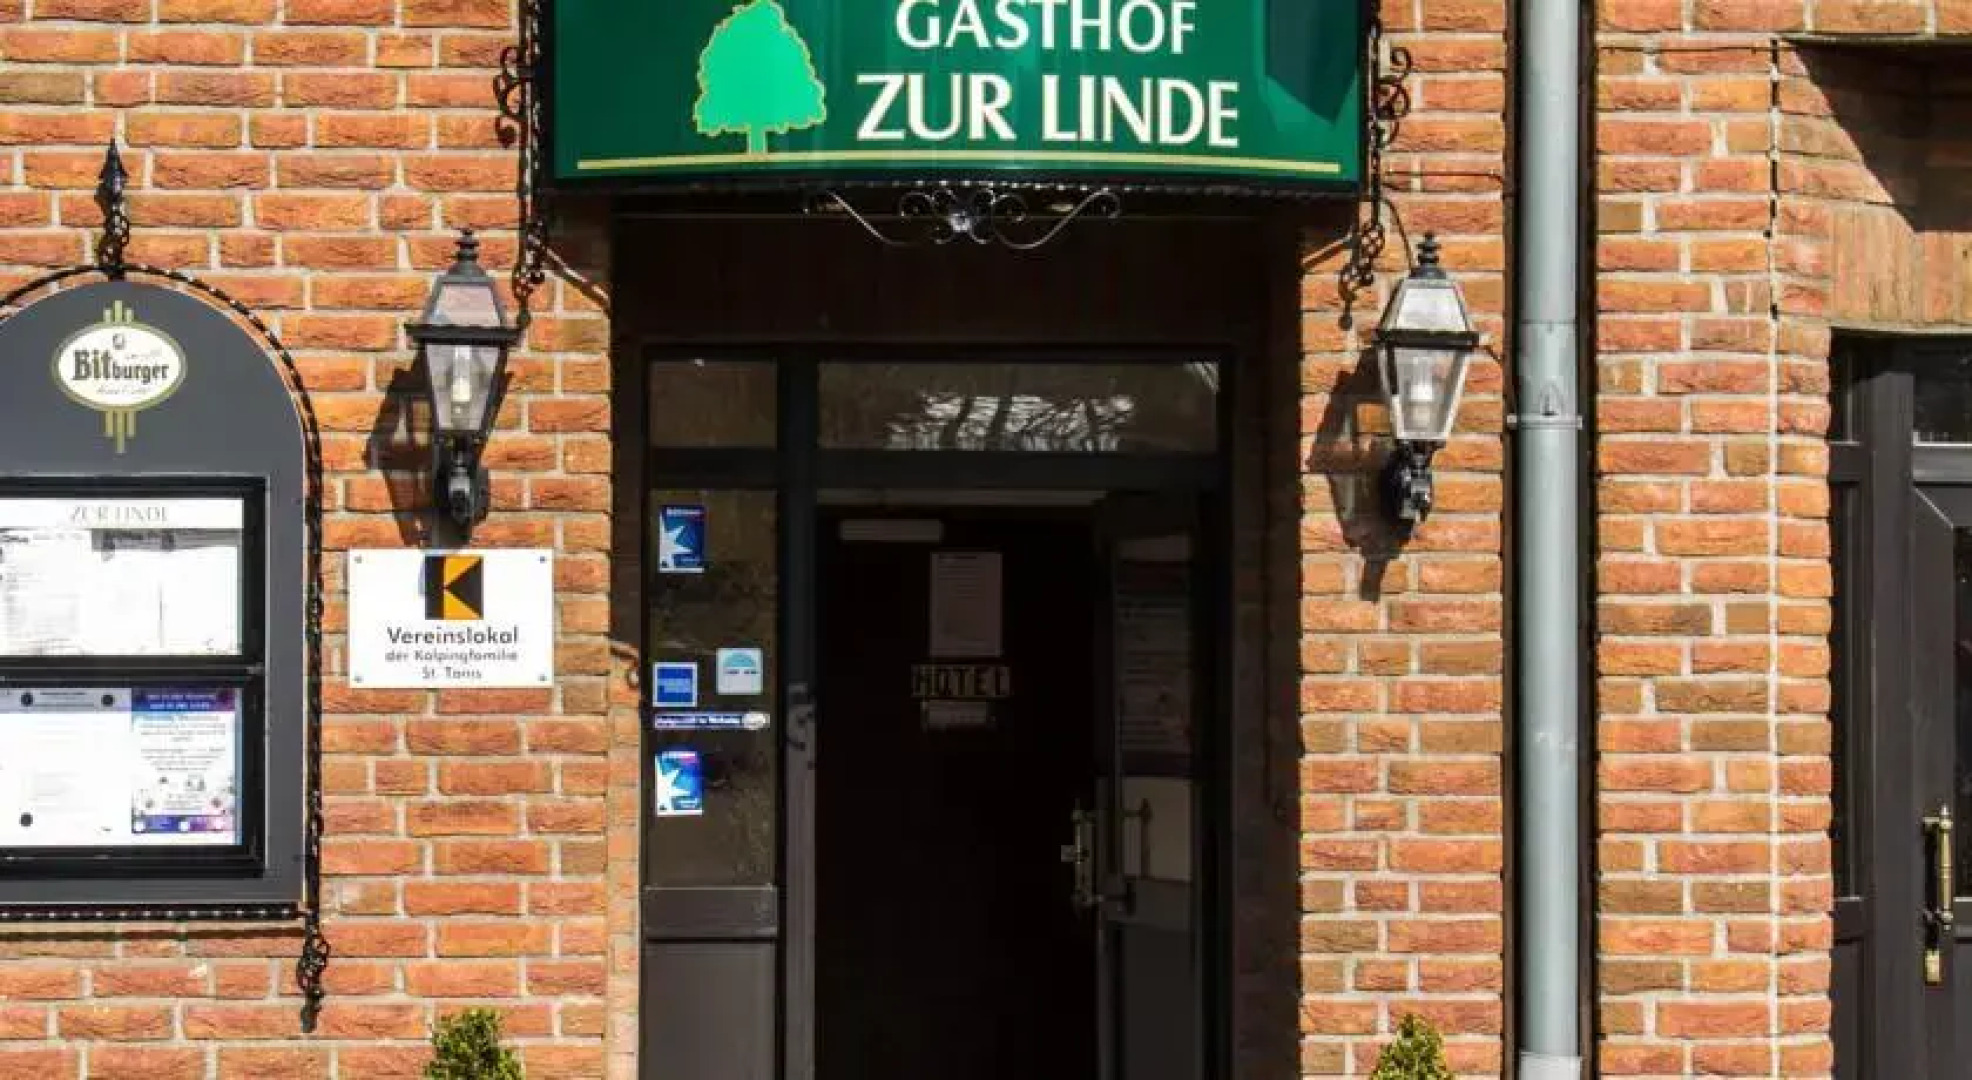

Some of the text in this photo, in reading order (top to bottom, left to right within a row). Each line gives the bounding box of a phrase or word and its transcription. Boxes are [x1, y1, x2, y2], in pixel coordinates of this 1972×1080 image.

[896, 0, 1195, 54] GASTHOF
[856, 73, 1240, 148] ZUR LINDE
[73, 350, 169, 385] Bitburger
[387, 626, 518, 644] Vereinslokal
[385, 648, 409, 661] der
